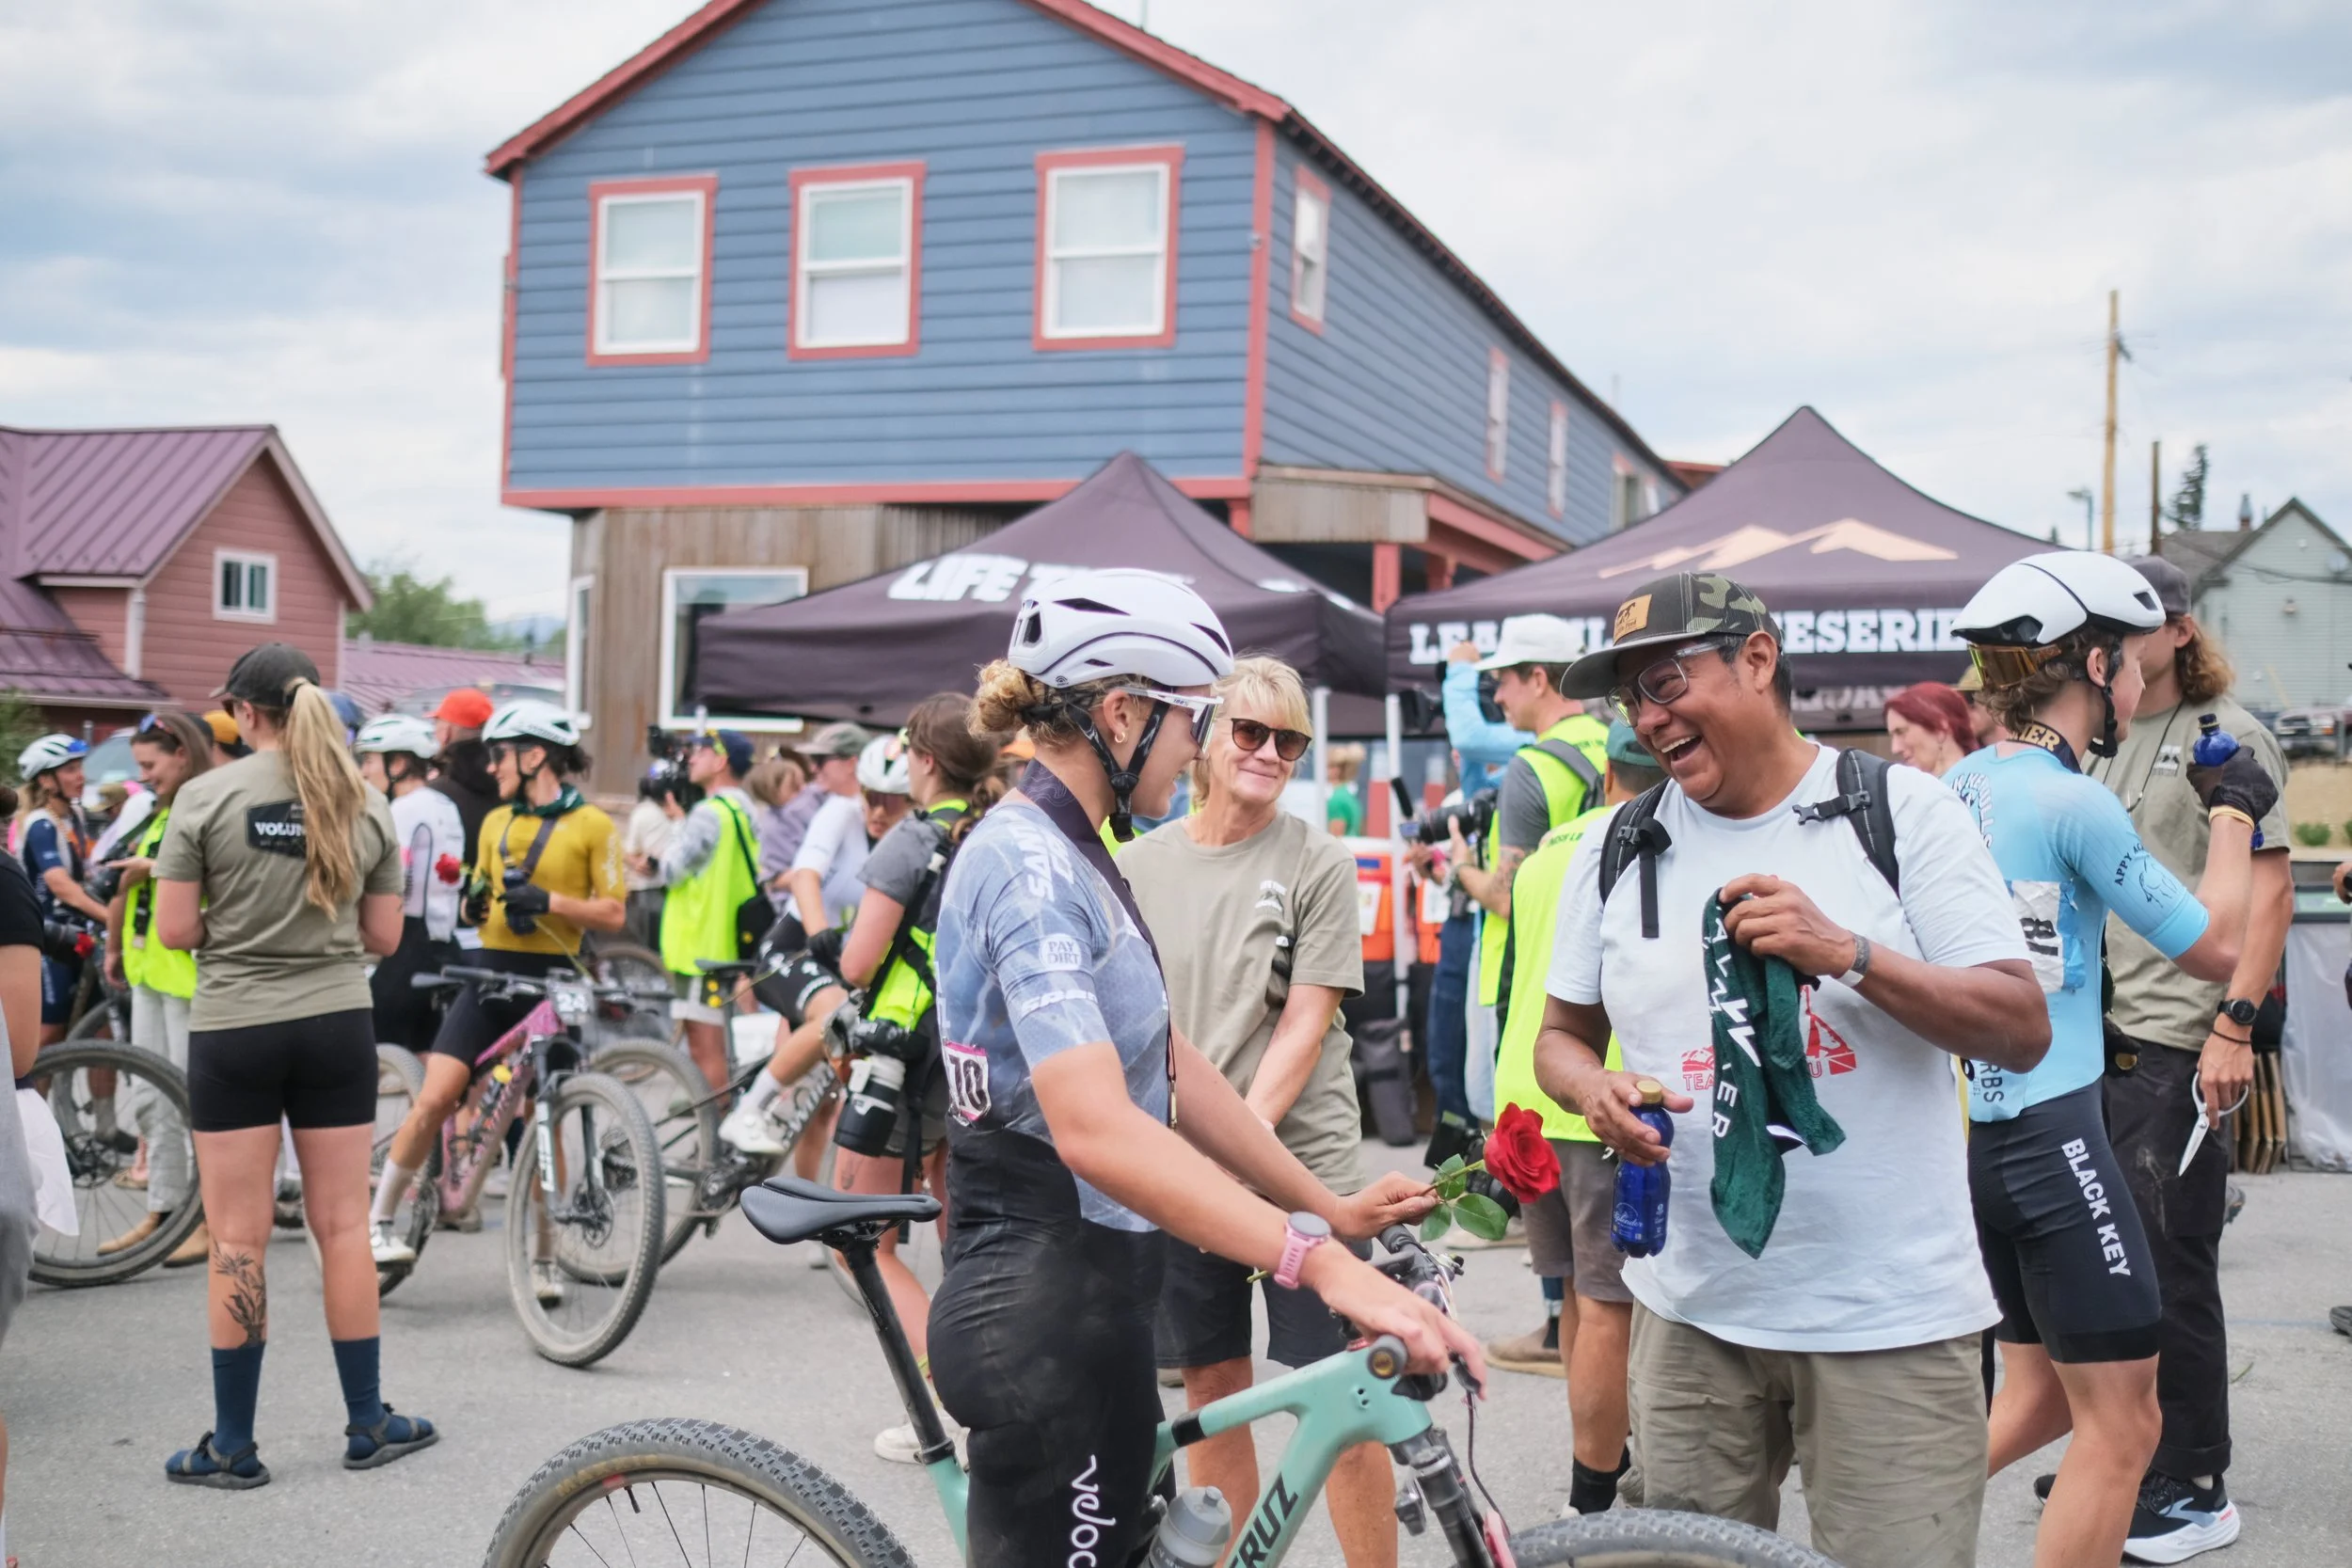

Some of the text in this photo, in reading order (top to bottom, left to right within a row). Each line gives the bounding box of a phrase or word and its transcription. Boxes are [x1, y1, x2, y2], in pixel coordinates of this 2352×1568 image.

[887, 553, 1029, 602] LIFE
[254, 821, 308, 837] VOLUN
[1047, 952, 1080, 965] DIRT
[1048, 941, 1074, 952] PAY
[2060, 1137, 2132, 1276] BLACK KEY
[1227, 1471, 1299, 1568] RUZ
